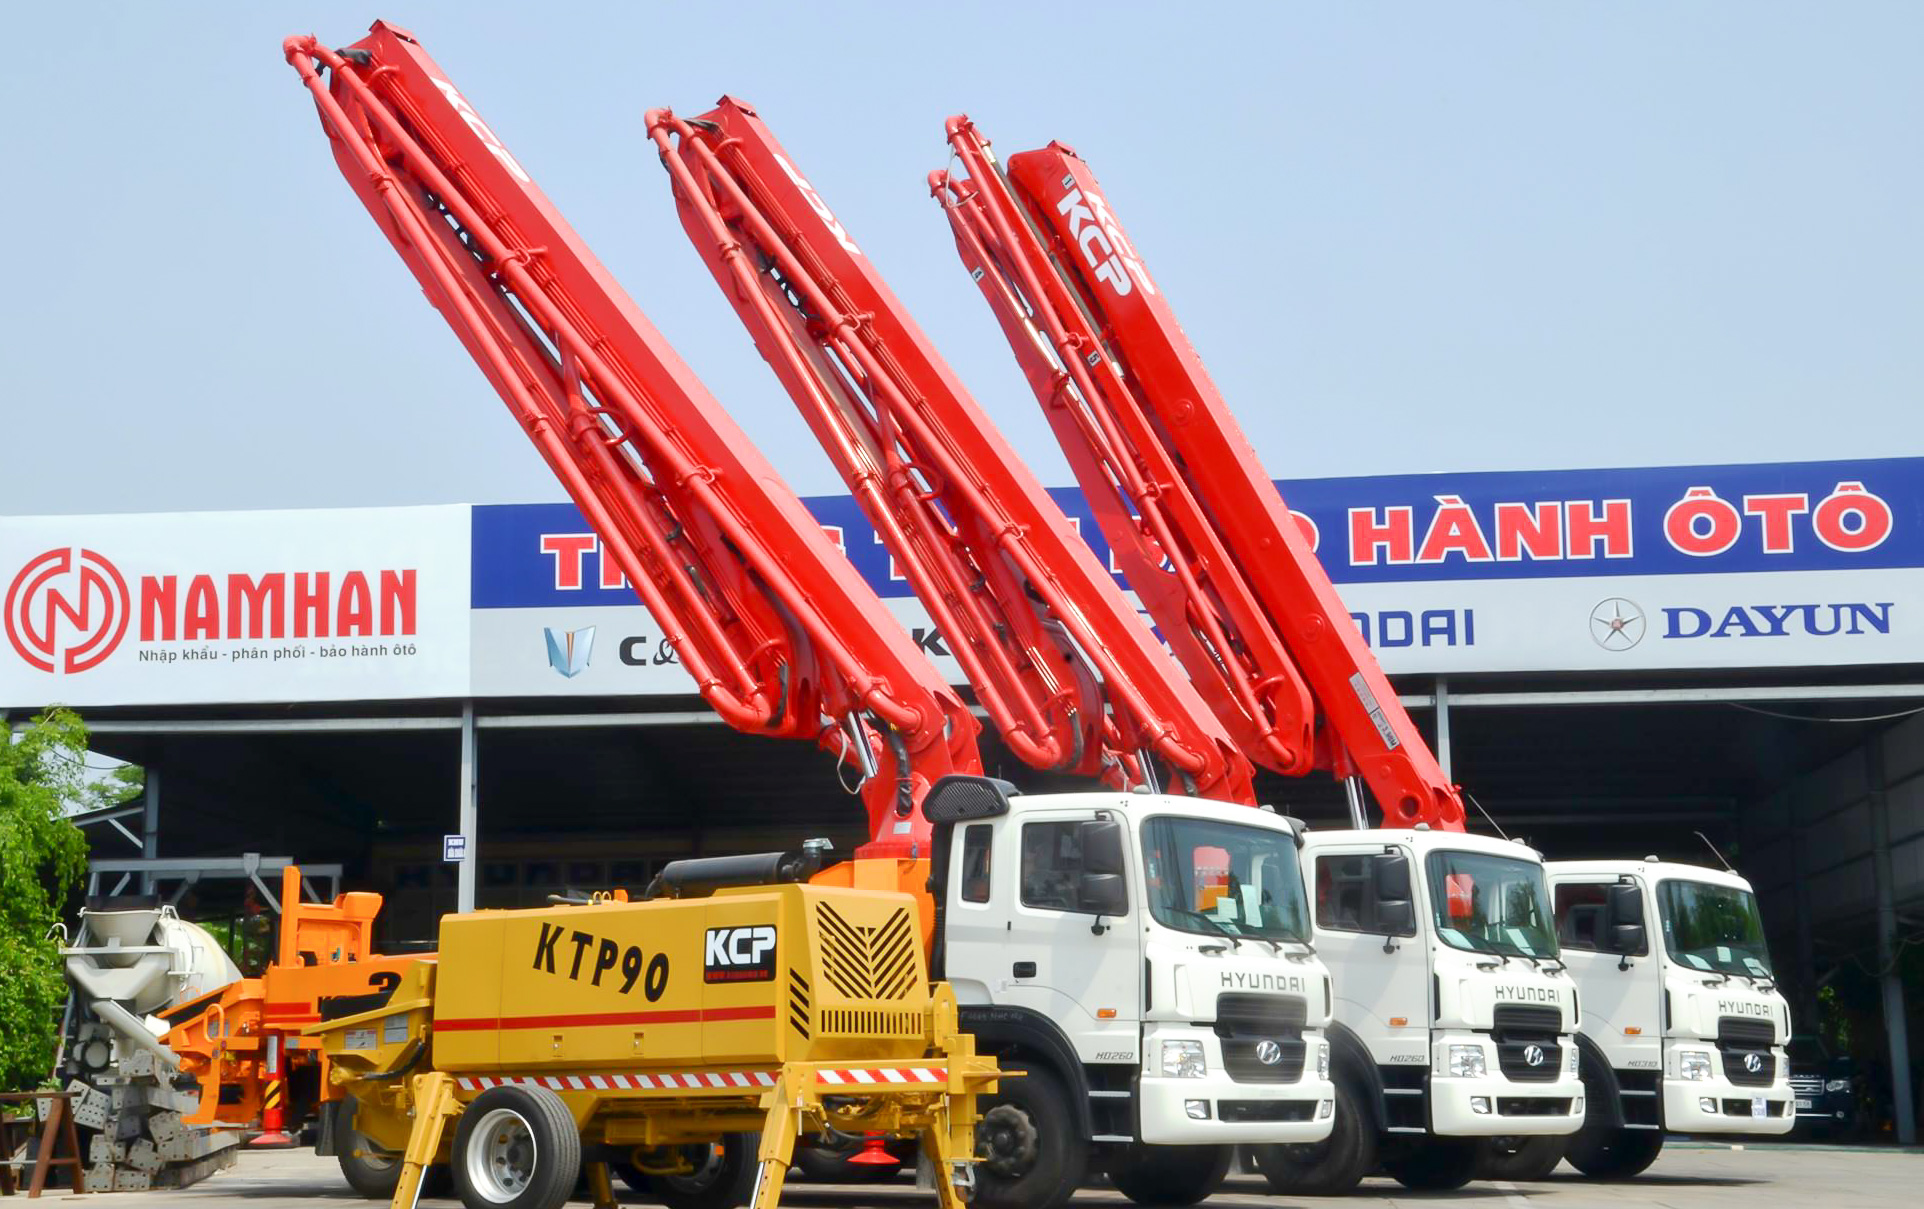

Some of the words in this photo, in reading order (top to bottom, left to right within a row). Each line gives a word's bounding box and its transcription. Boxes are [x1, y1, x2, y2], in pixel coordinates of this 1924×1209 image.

[1057, 187, 1132, 296] KCP
[1348, 495, 1634, 566] HÀNH
[1663, 481, 1894, 557] ÔTÔ
[140, 569, 417, 641] NAMHAN
[1661, 602, 1894, 639] DAYUN
[139, 650, 178, 664] Nhập
[182, 645, 218, 660] khẩu
[232, 647, 268, 662] phân
[273, 644, 306, 661] phối
[320, 643, 347, 658] bảo
[351, 644, 388, 657] hành
[393, 643, 417, 656] ôtô
[532, 921, 669, 1002] KTP90
[705, 926, 776, 967] KCP
[1220, 971, 1306, 992] HYUNDAI
[1494, 985, 1561, 1003] HYUNDAI
[1718, 1000, 1774, 1018] HYUNDAI
[1095, 1051, 1134, 1060] HD260
